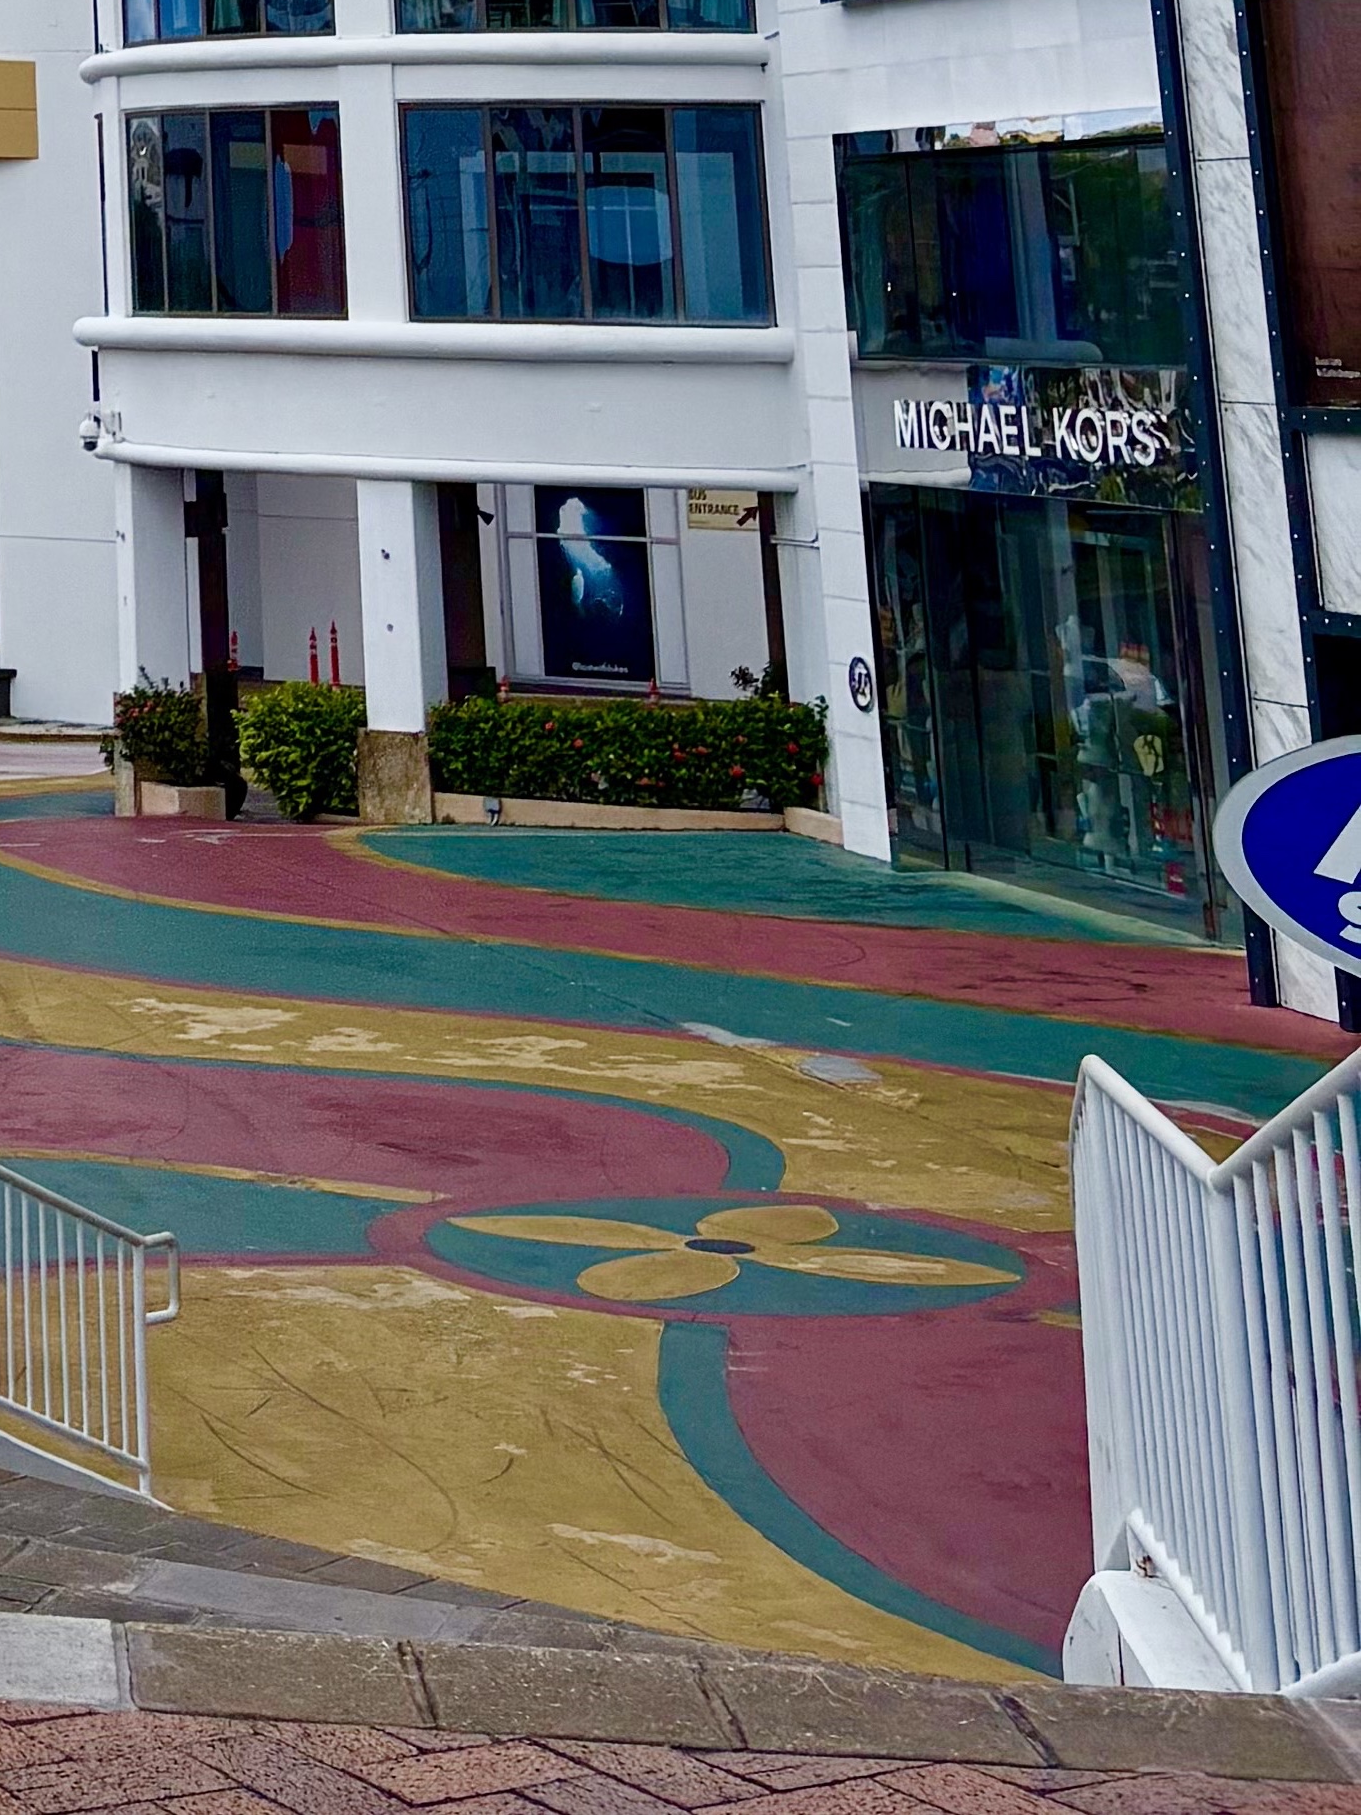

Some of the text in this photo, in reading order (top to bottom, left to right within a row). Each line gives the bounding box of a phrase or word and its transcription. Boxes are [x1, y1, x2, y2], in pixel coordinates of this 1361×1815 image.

[894, 399, 1156, 466] MICHAEL KORS
[689, 503, 740, 515] ENTRANCE
